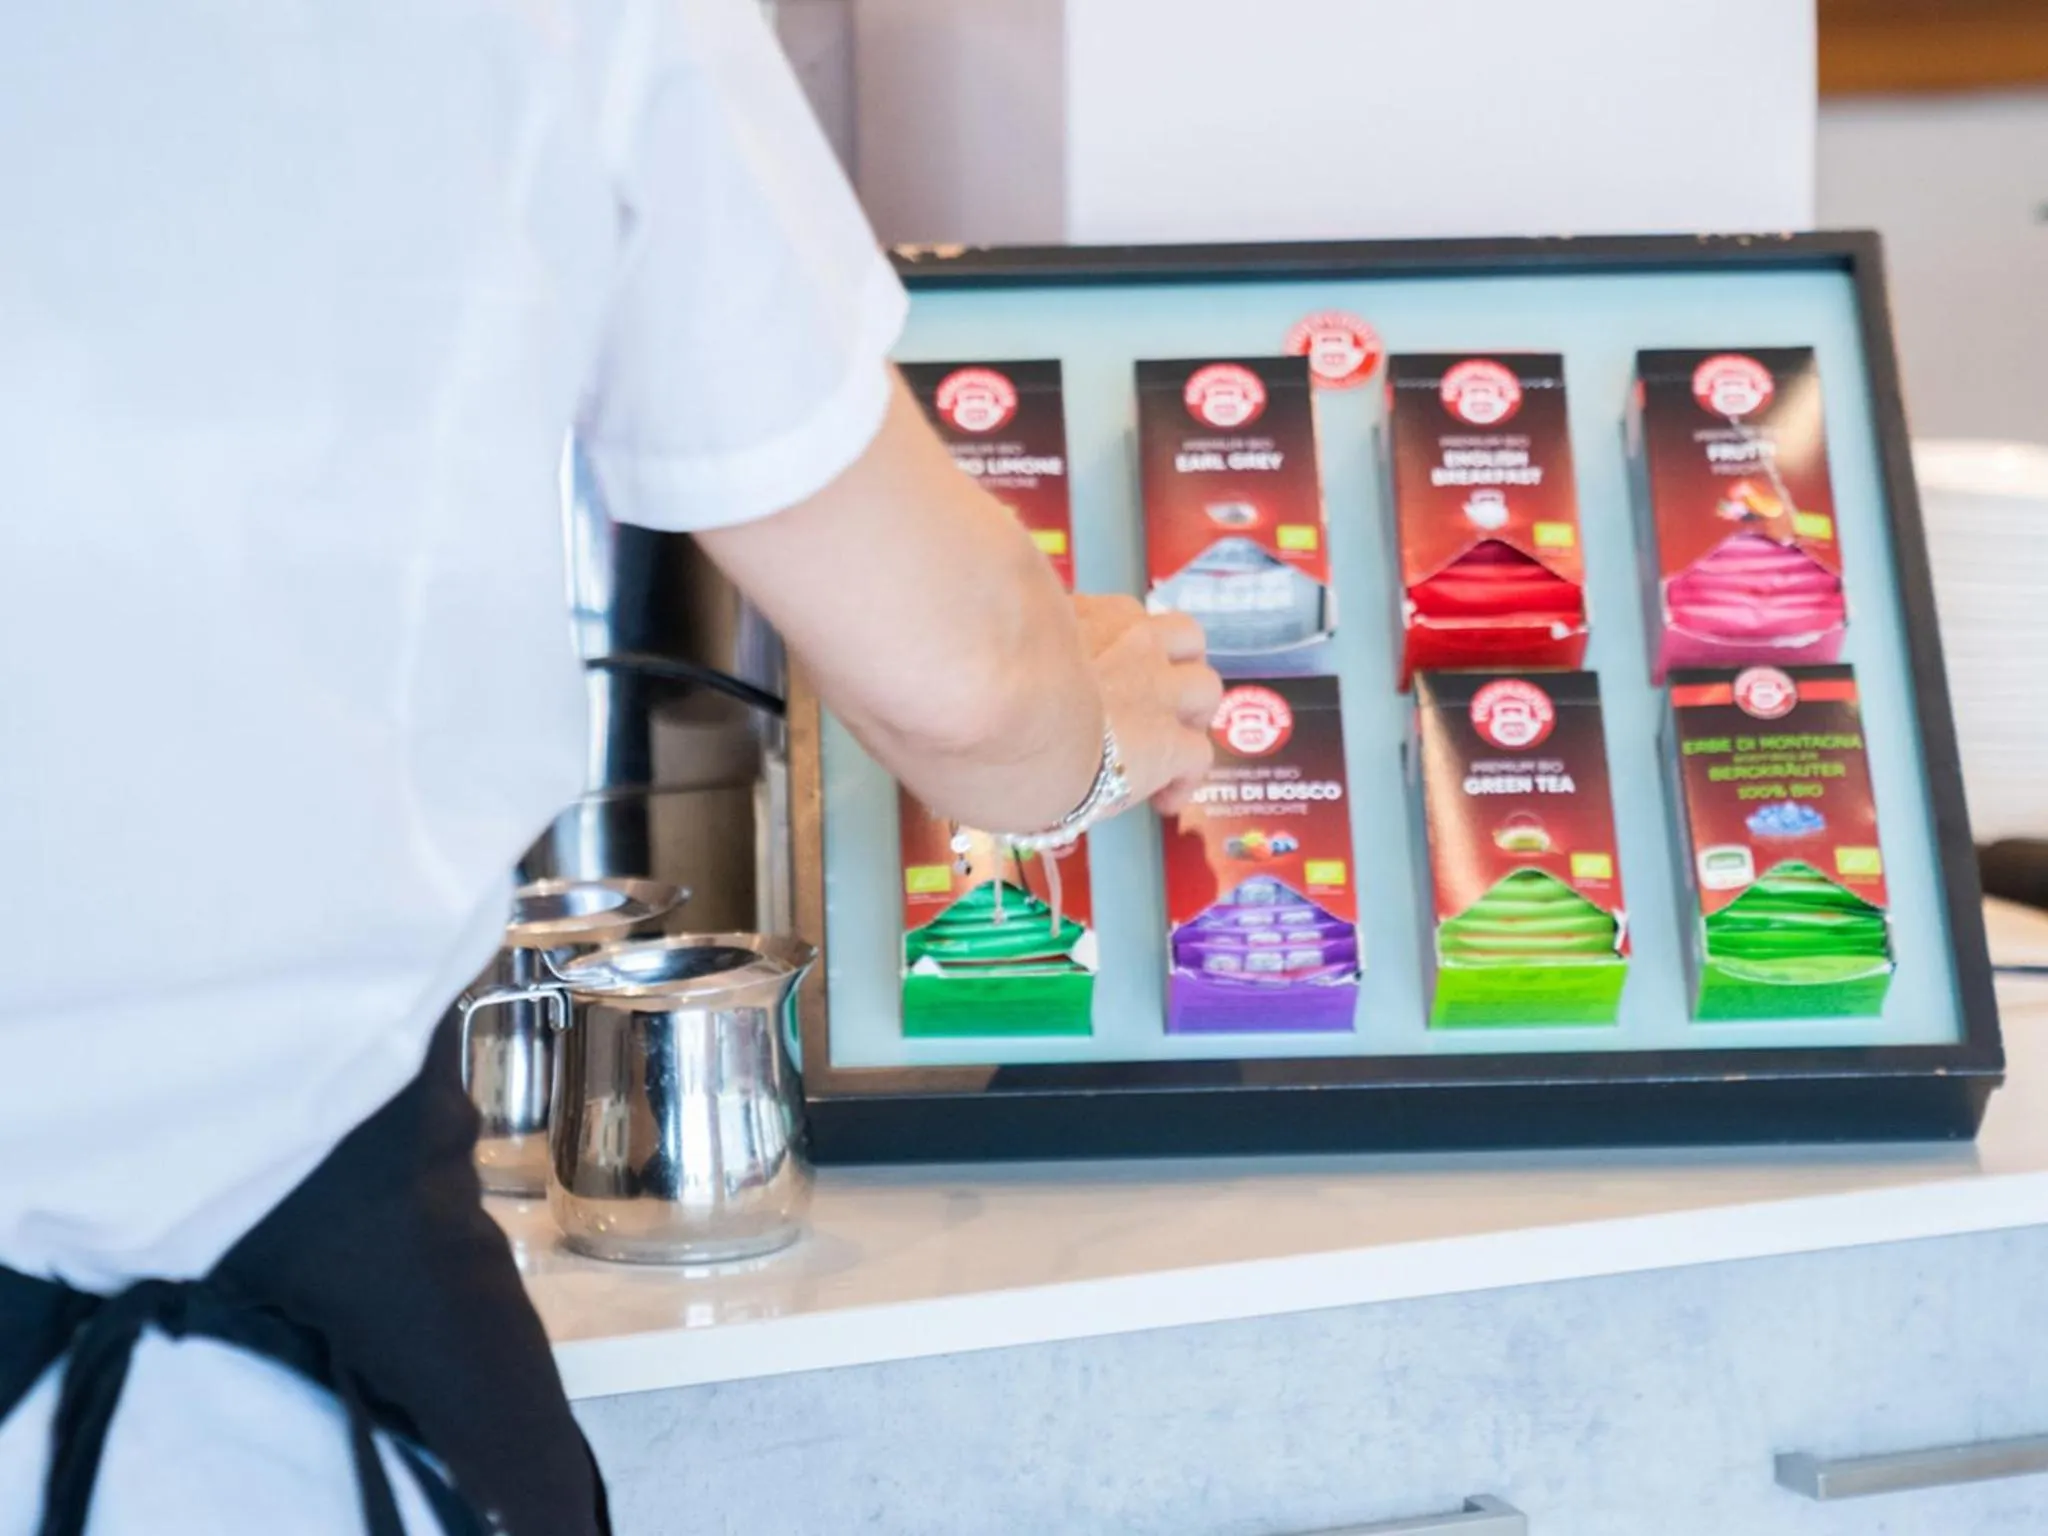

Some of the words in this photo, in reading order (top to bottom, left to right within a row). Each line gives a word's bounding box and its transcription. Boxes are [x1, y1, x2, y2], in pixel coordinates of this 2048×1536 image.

[1174, 451, 1227, 473] EARL
[1227, 450, 1284, 471] GREY
[1735, 735, 1757, 751] DI
[1239, 781, 1265, 801] DI
[1266, 779, 1343, 801] BOSCO
[1463, 774, 1533, 796] GREEN
[1534, 773, 1577, 795] TEA
